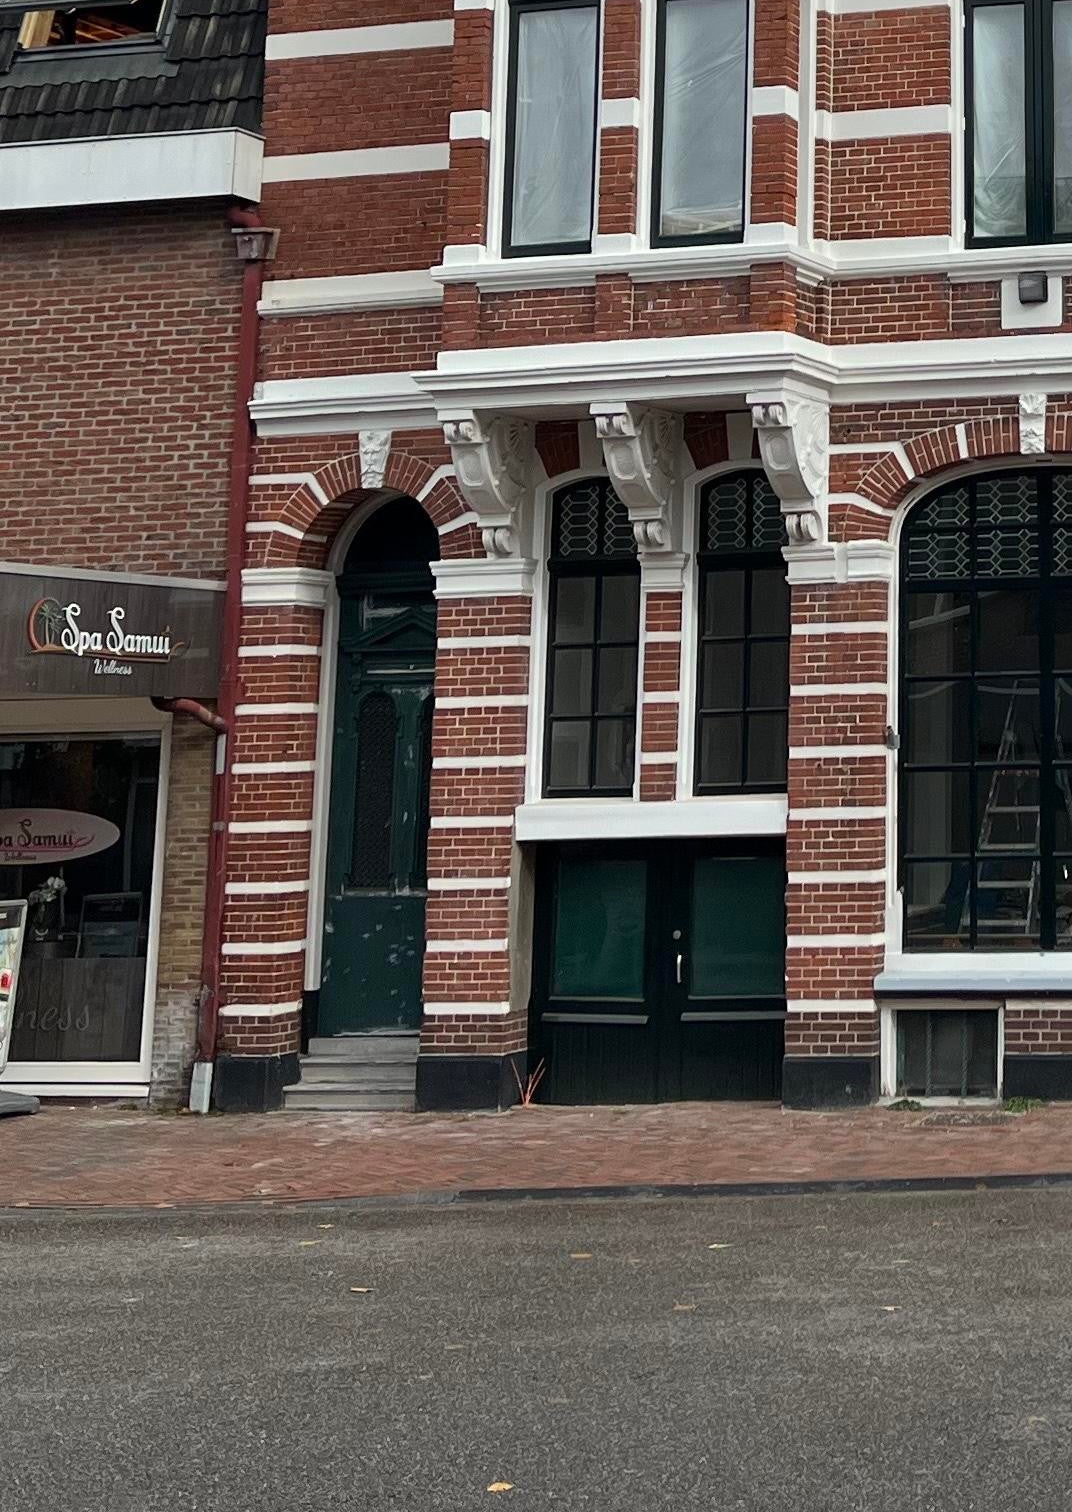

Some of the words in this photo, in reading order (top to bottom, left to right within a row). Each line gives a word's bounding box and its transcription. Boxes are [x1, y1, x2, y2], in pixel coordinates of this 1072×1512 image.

[61, 603, 103, 656] Spa
[106, 607, 170, 655] Samui
[94, 659, 132, 675] Wellness
[17, 818, 74, 847] Samui
